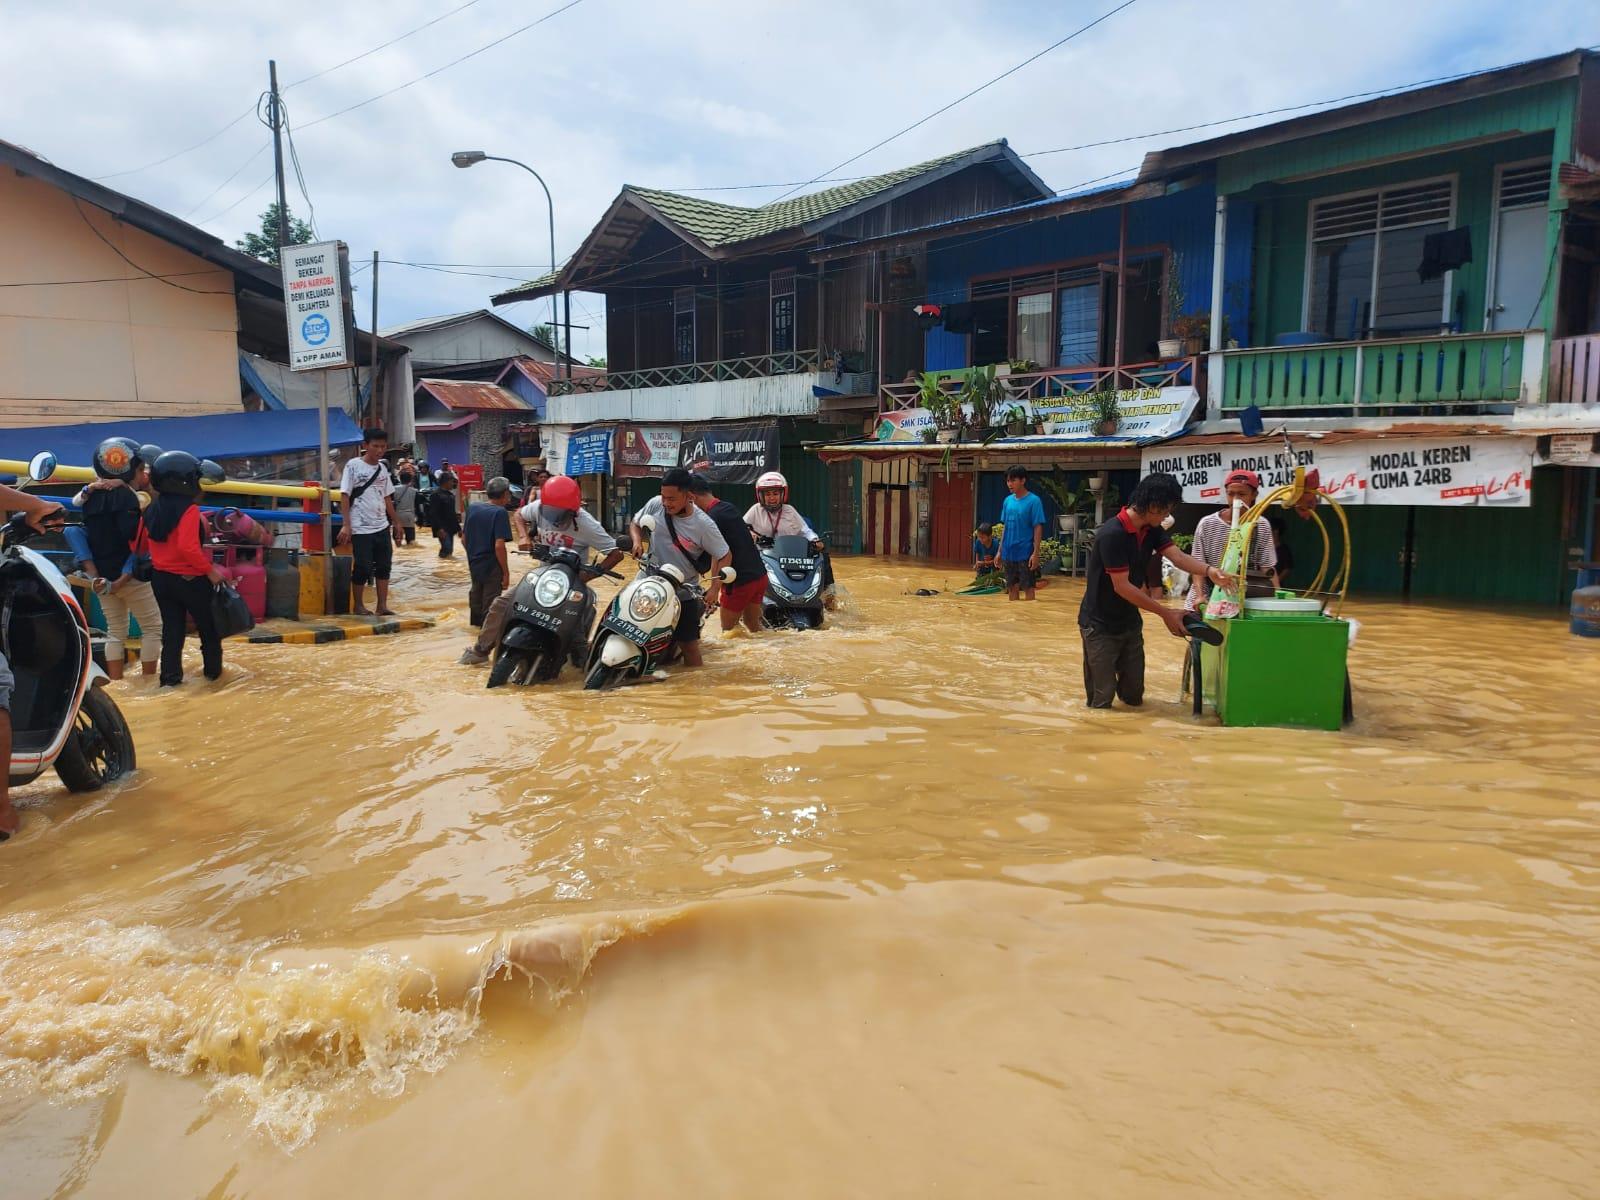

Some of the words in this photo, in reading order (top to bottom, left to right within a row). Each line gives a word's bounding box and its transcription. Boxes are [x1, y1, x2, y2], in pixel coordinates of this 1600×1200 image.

[295, 255, 325, 267] SEMANGAT
[298, 267, 323, 278] BEKERJA
[289, 280, 307, 290] TANPA
[308, 276, 335, 288] NARKOBA
[291, 292, 305, 302] DEMI
[306, 288, 335, 300] KELUARGA
[298, 300, 330, 312] SEJAHTERA
[320, 351, 342, 360] AMAN
[1140, 387, 1161, 400] DAN
[900, 418, 915, 429] SMK
[1126, 421, 1150, 430] 2017
[714, 442, 734, 453] TETAP
[735, 441, 766, 453] MANTAP!
[755, 455, 765, 467] 16
[1149, 457, 1184, 474] MODAL
[1187, 452, 1222, 470] KEREN
[1231, 455, 1271, 471] MODAL
[1370, 451, 1418, 471] MODAL
[1422, 445, 1471, 466] KEREN
[1181, 471, 1208, 487] 24RB
[1371, 471, 1409, 489] CUMA
[1414, 467, 1453, 486] 24RB
